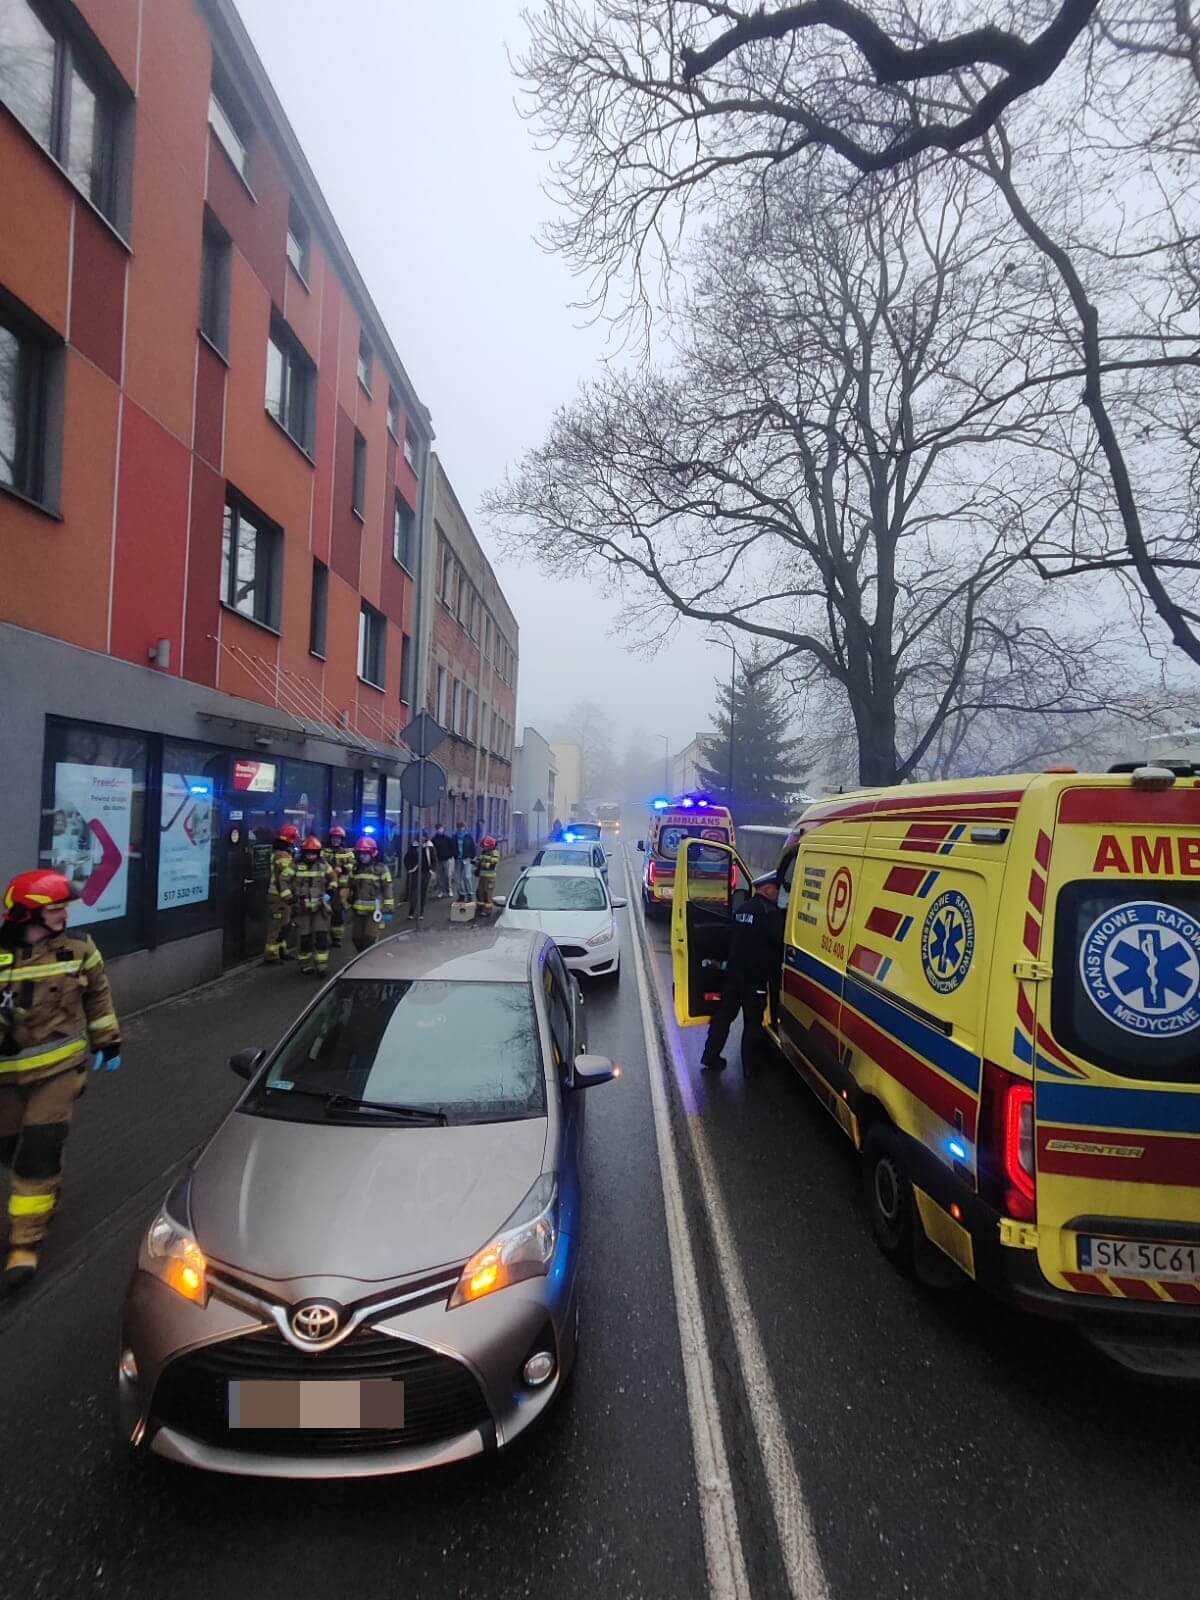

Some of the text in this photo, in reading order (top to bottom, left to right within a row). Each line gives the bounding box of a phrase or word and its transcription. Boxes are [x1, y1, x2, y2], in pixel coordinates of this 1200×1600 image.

[666, 815, 721, 826] AMBULANS
[1093, 835, 1200, 875] AMB
[1086, 909, 1140, 1000] PAŃSTWOWE
[1113, 1004, 1199, 1031] MEDYCZNE
[1049, 1141, 1141, 1156] SPRINTER
[1097, 1242, 1195, 1273] SK 5C61
